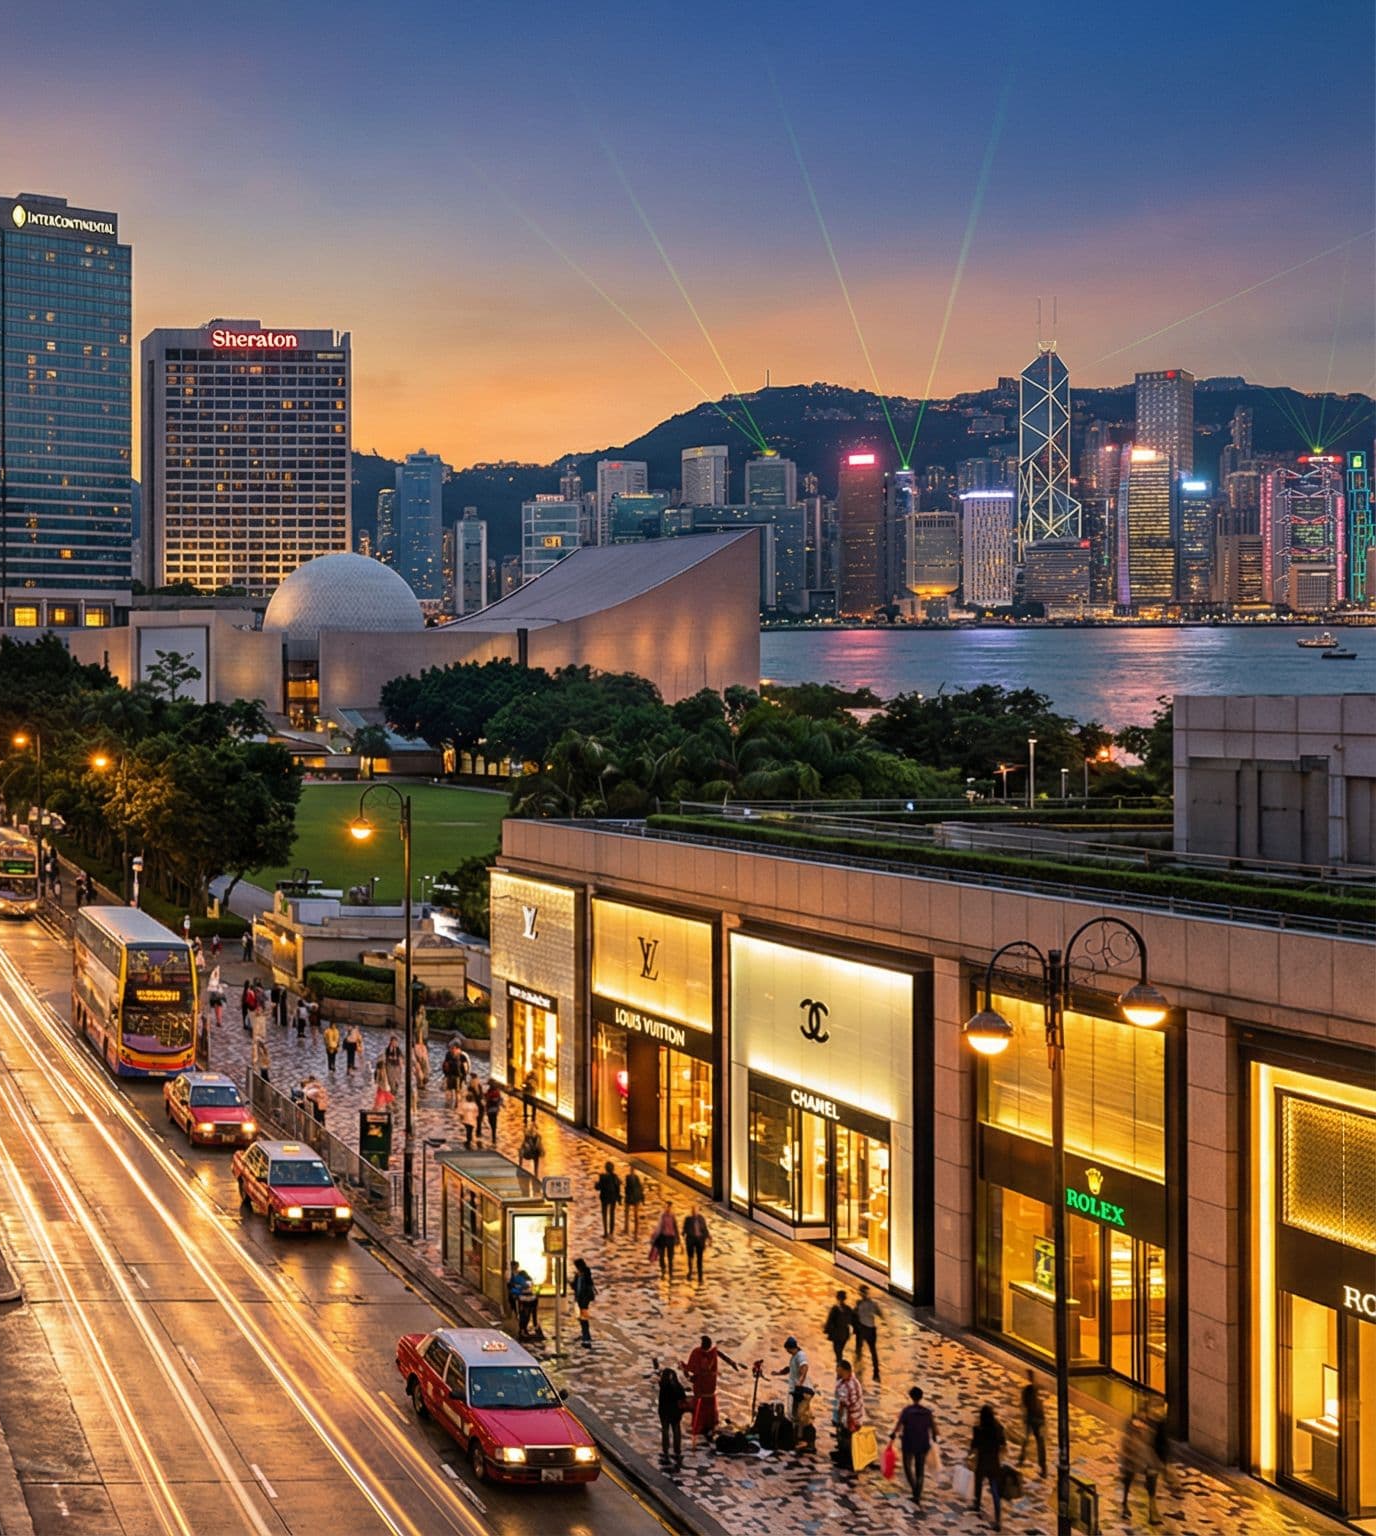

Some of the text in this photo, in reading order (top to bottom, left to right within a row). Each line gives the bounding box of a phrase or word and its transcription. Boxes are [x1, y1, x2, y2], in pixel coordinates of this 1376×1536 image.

[615, 1007, 685, 1047] LOUIS VUITTON
[790, 1089, 840, 1120] CHANEL
[1066, 1188, 1125, 1226] ROLEX
